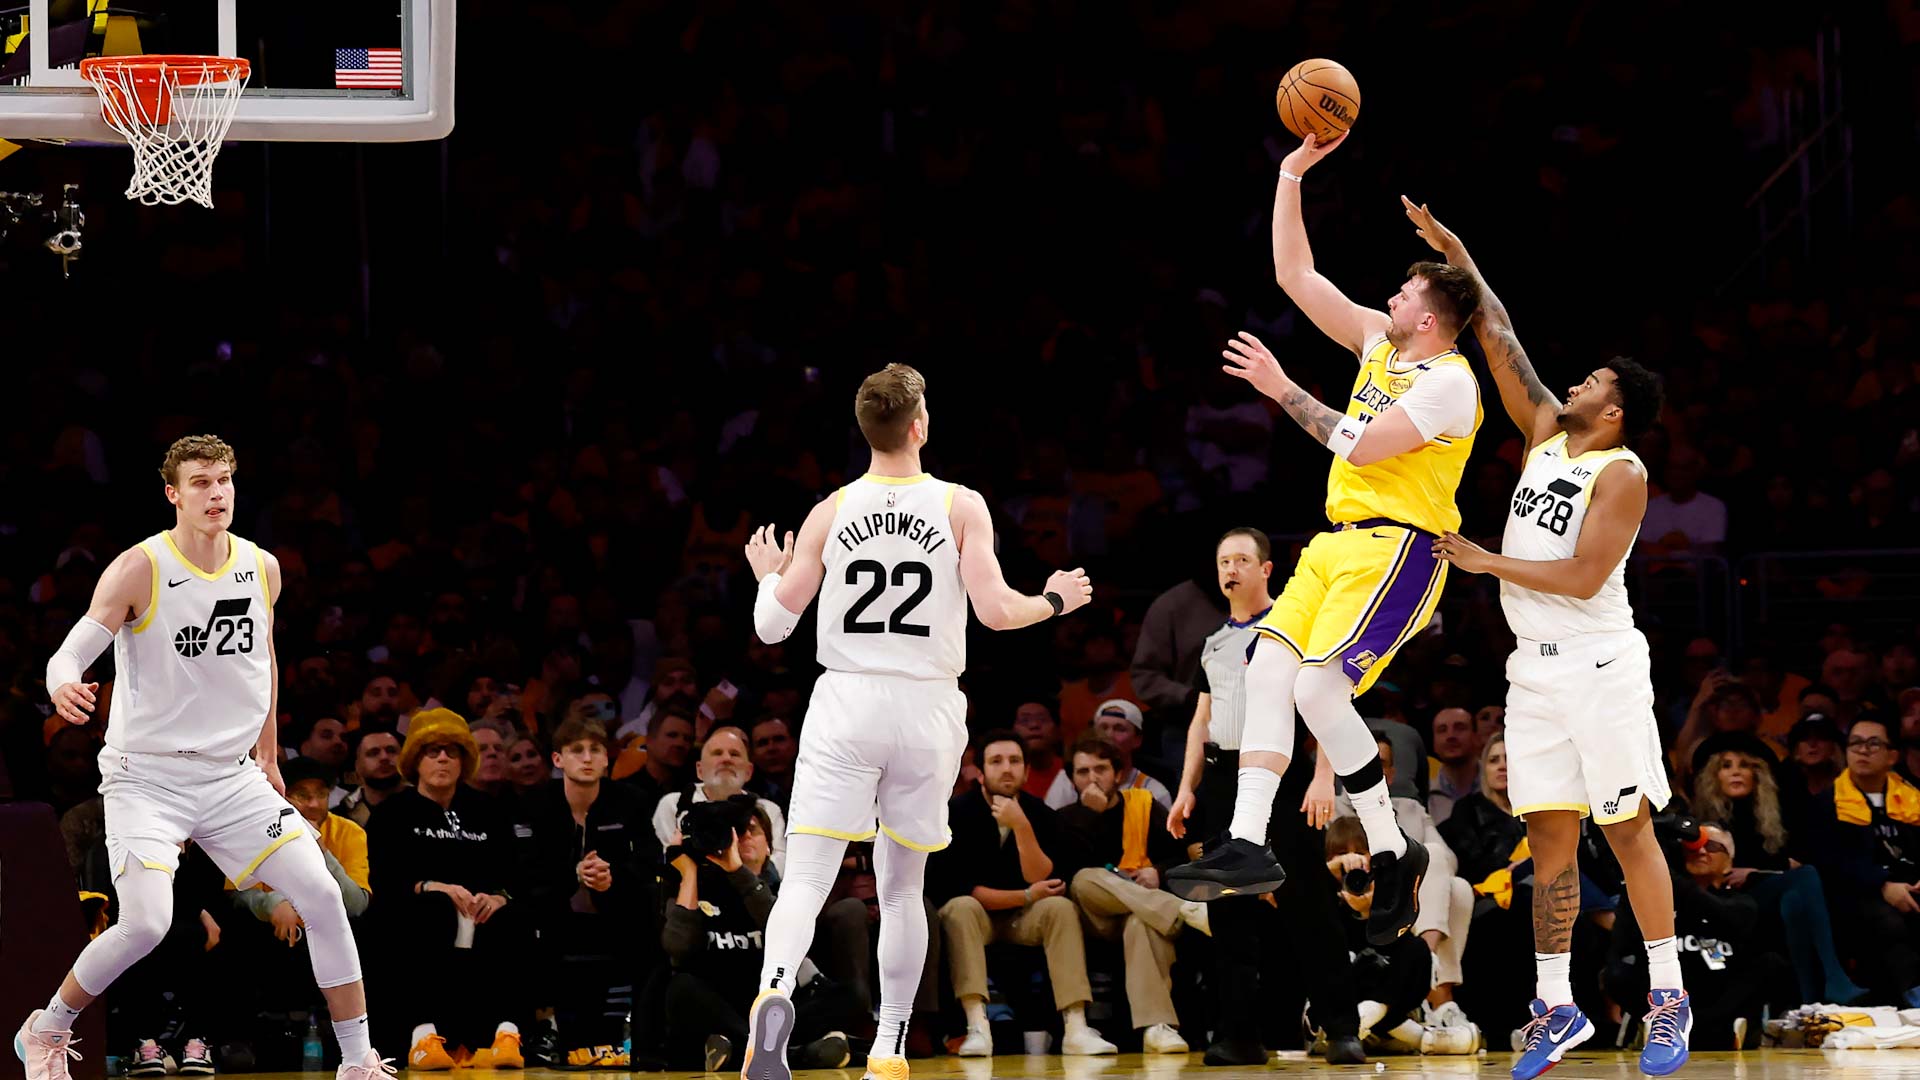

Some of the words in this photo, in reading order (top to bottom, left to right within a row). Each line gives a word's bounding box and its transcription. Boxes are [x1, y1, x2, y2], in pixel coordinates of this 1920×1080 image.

[837, 512, 946, 554] FILIPOWSKI
[1536, 494, 1574, 537] 28
[234, 571, 254, 583] LVT
[843, 559, 933, 638] 22
[215, 617, 254, 656] 23
[707, 930, 763, 950] PHOT
